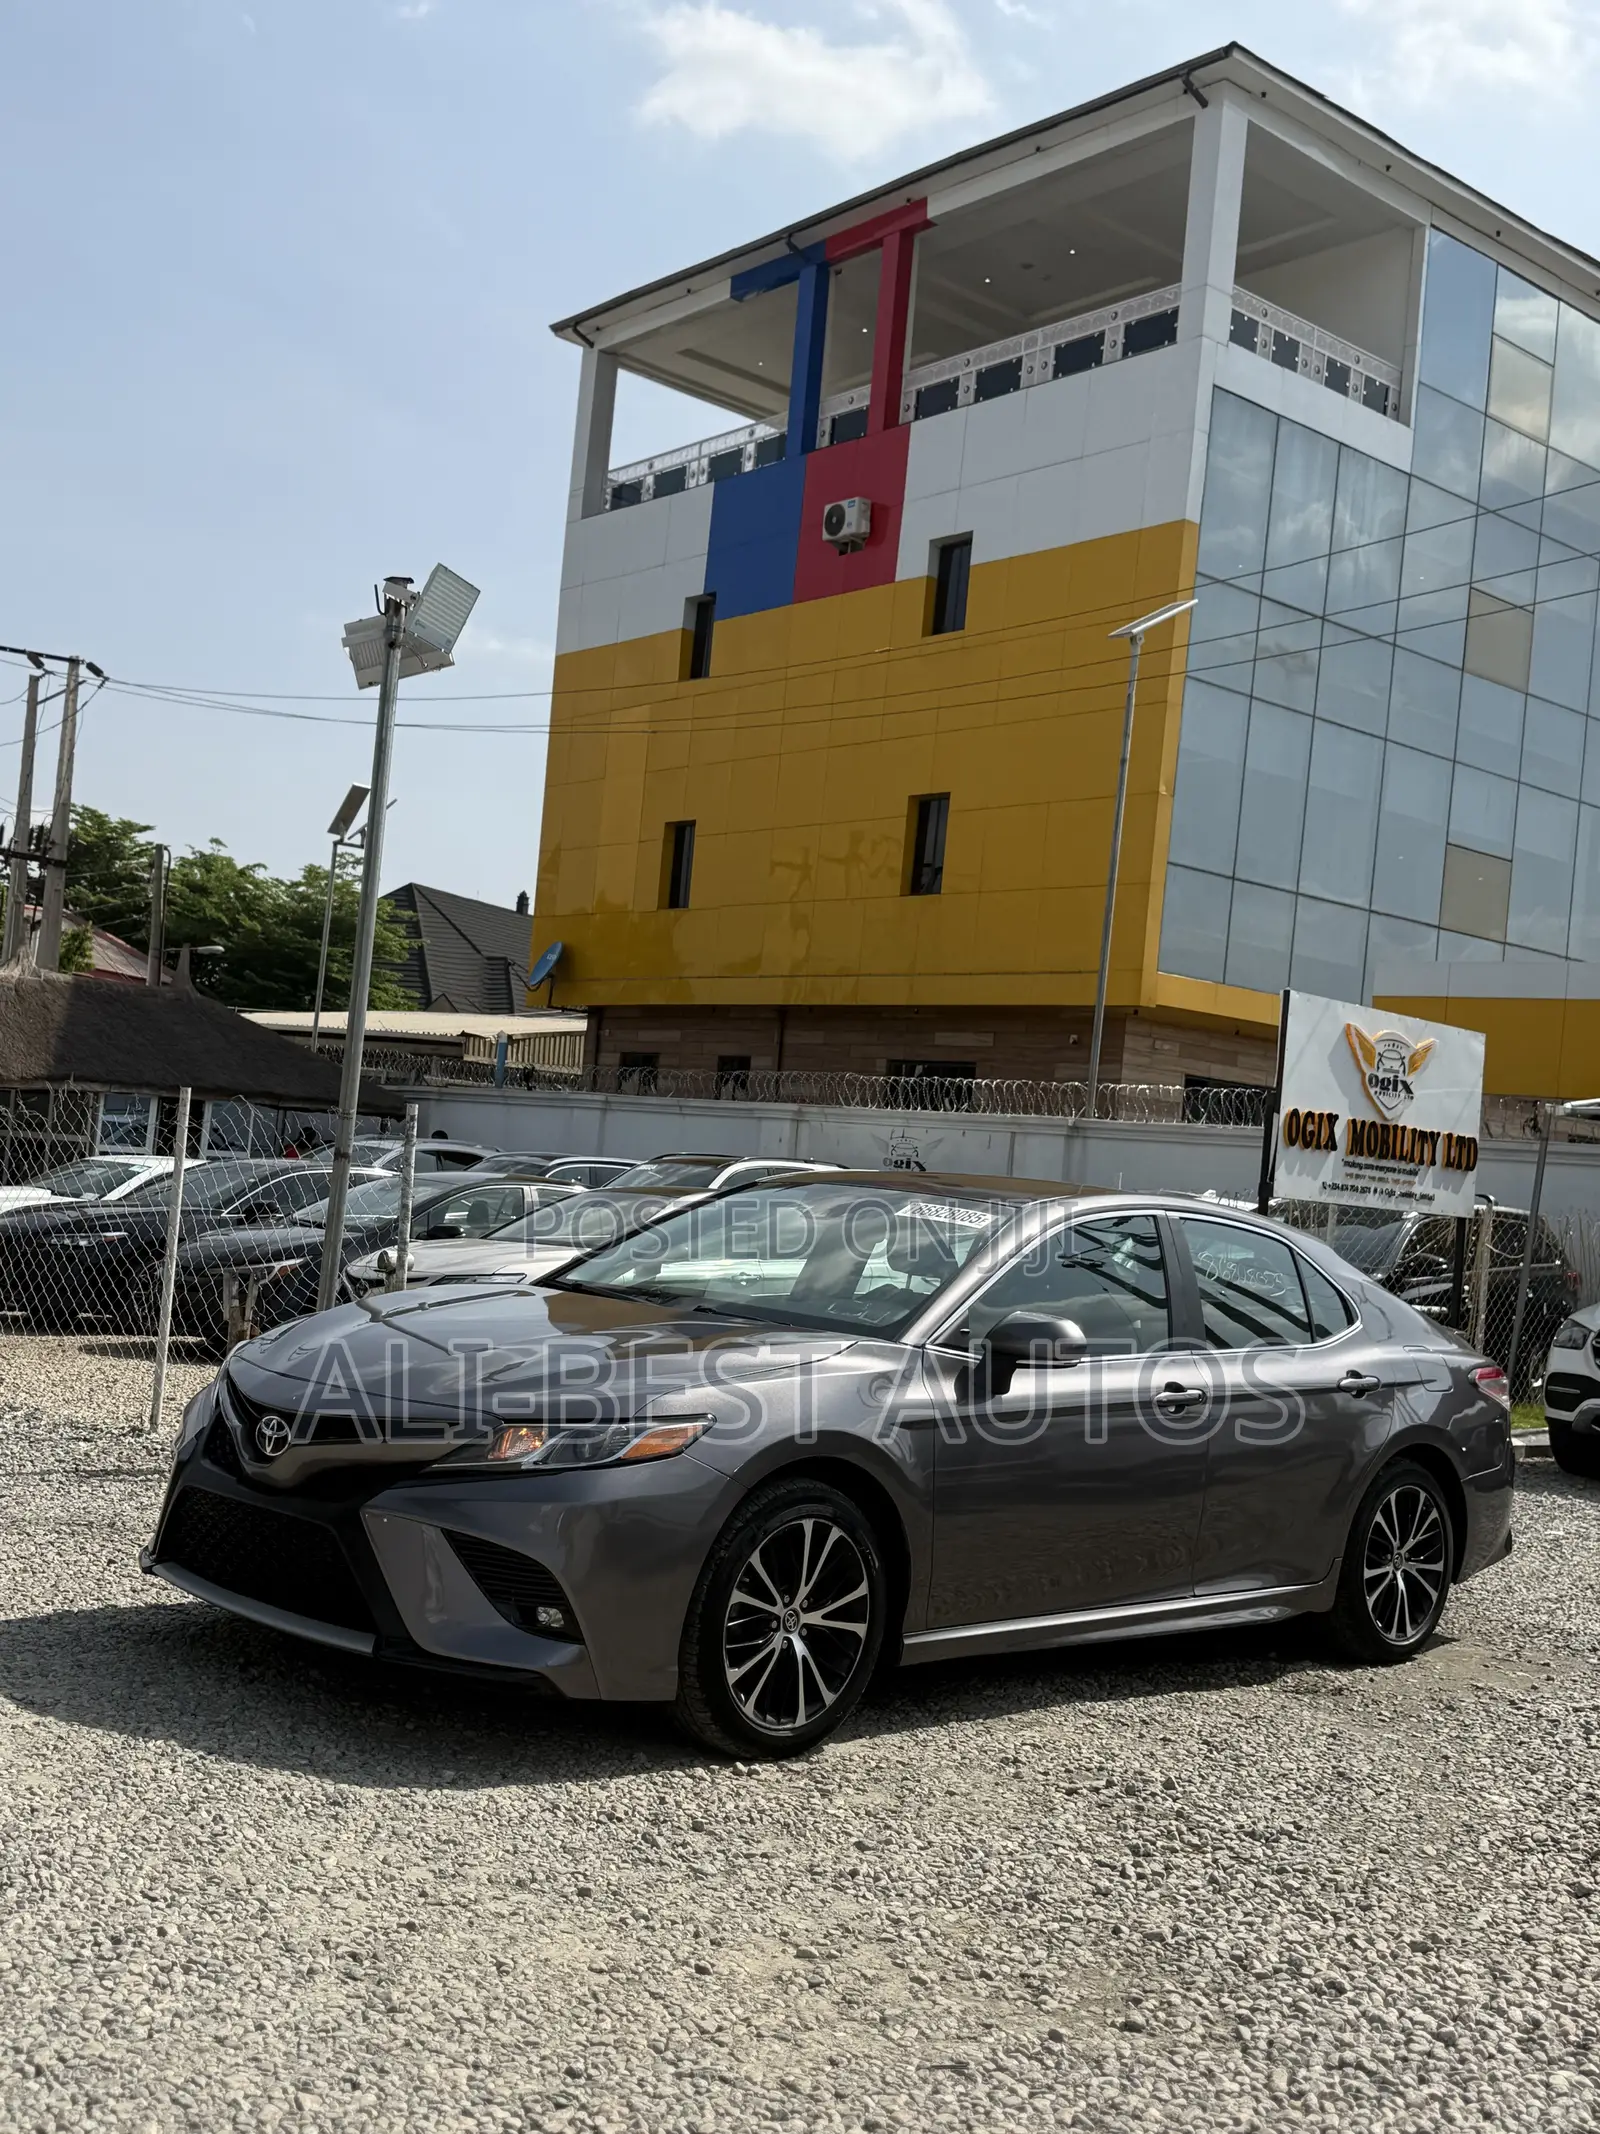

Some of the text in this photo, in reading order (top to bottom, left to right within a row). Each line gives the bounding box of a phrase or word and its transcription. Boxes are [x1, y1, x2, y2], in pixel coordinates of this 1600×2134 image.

[1284, 1108, 1478, 1171] OGIX MOBILITY LTD
